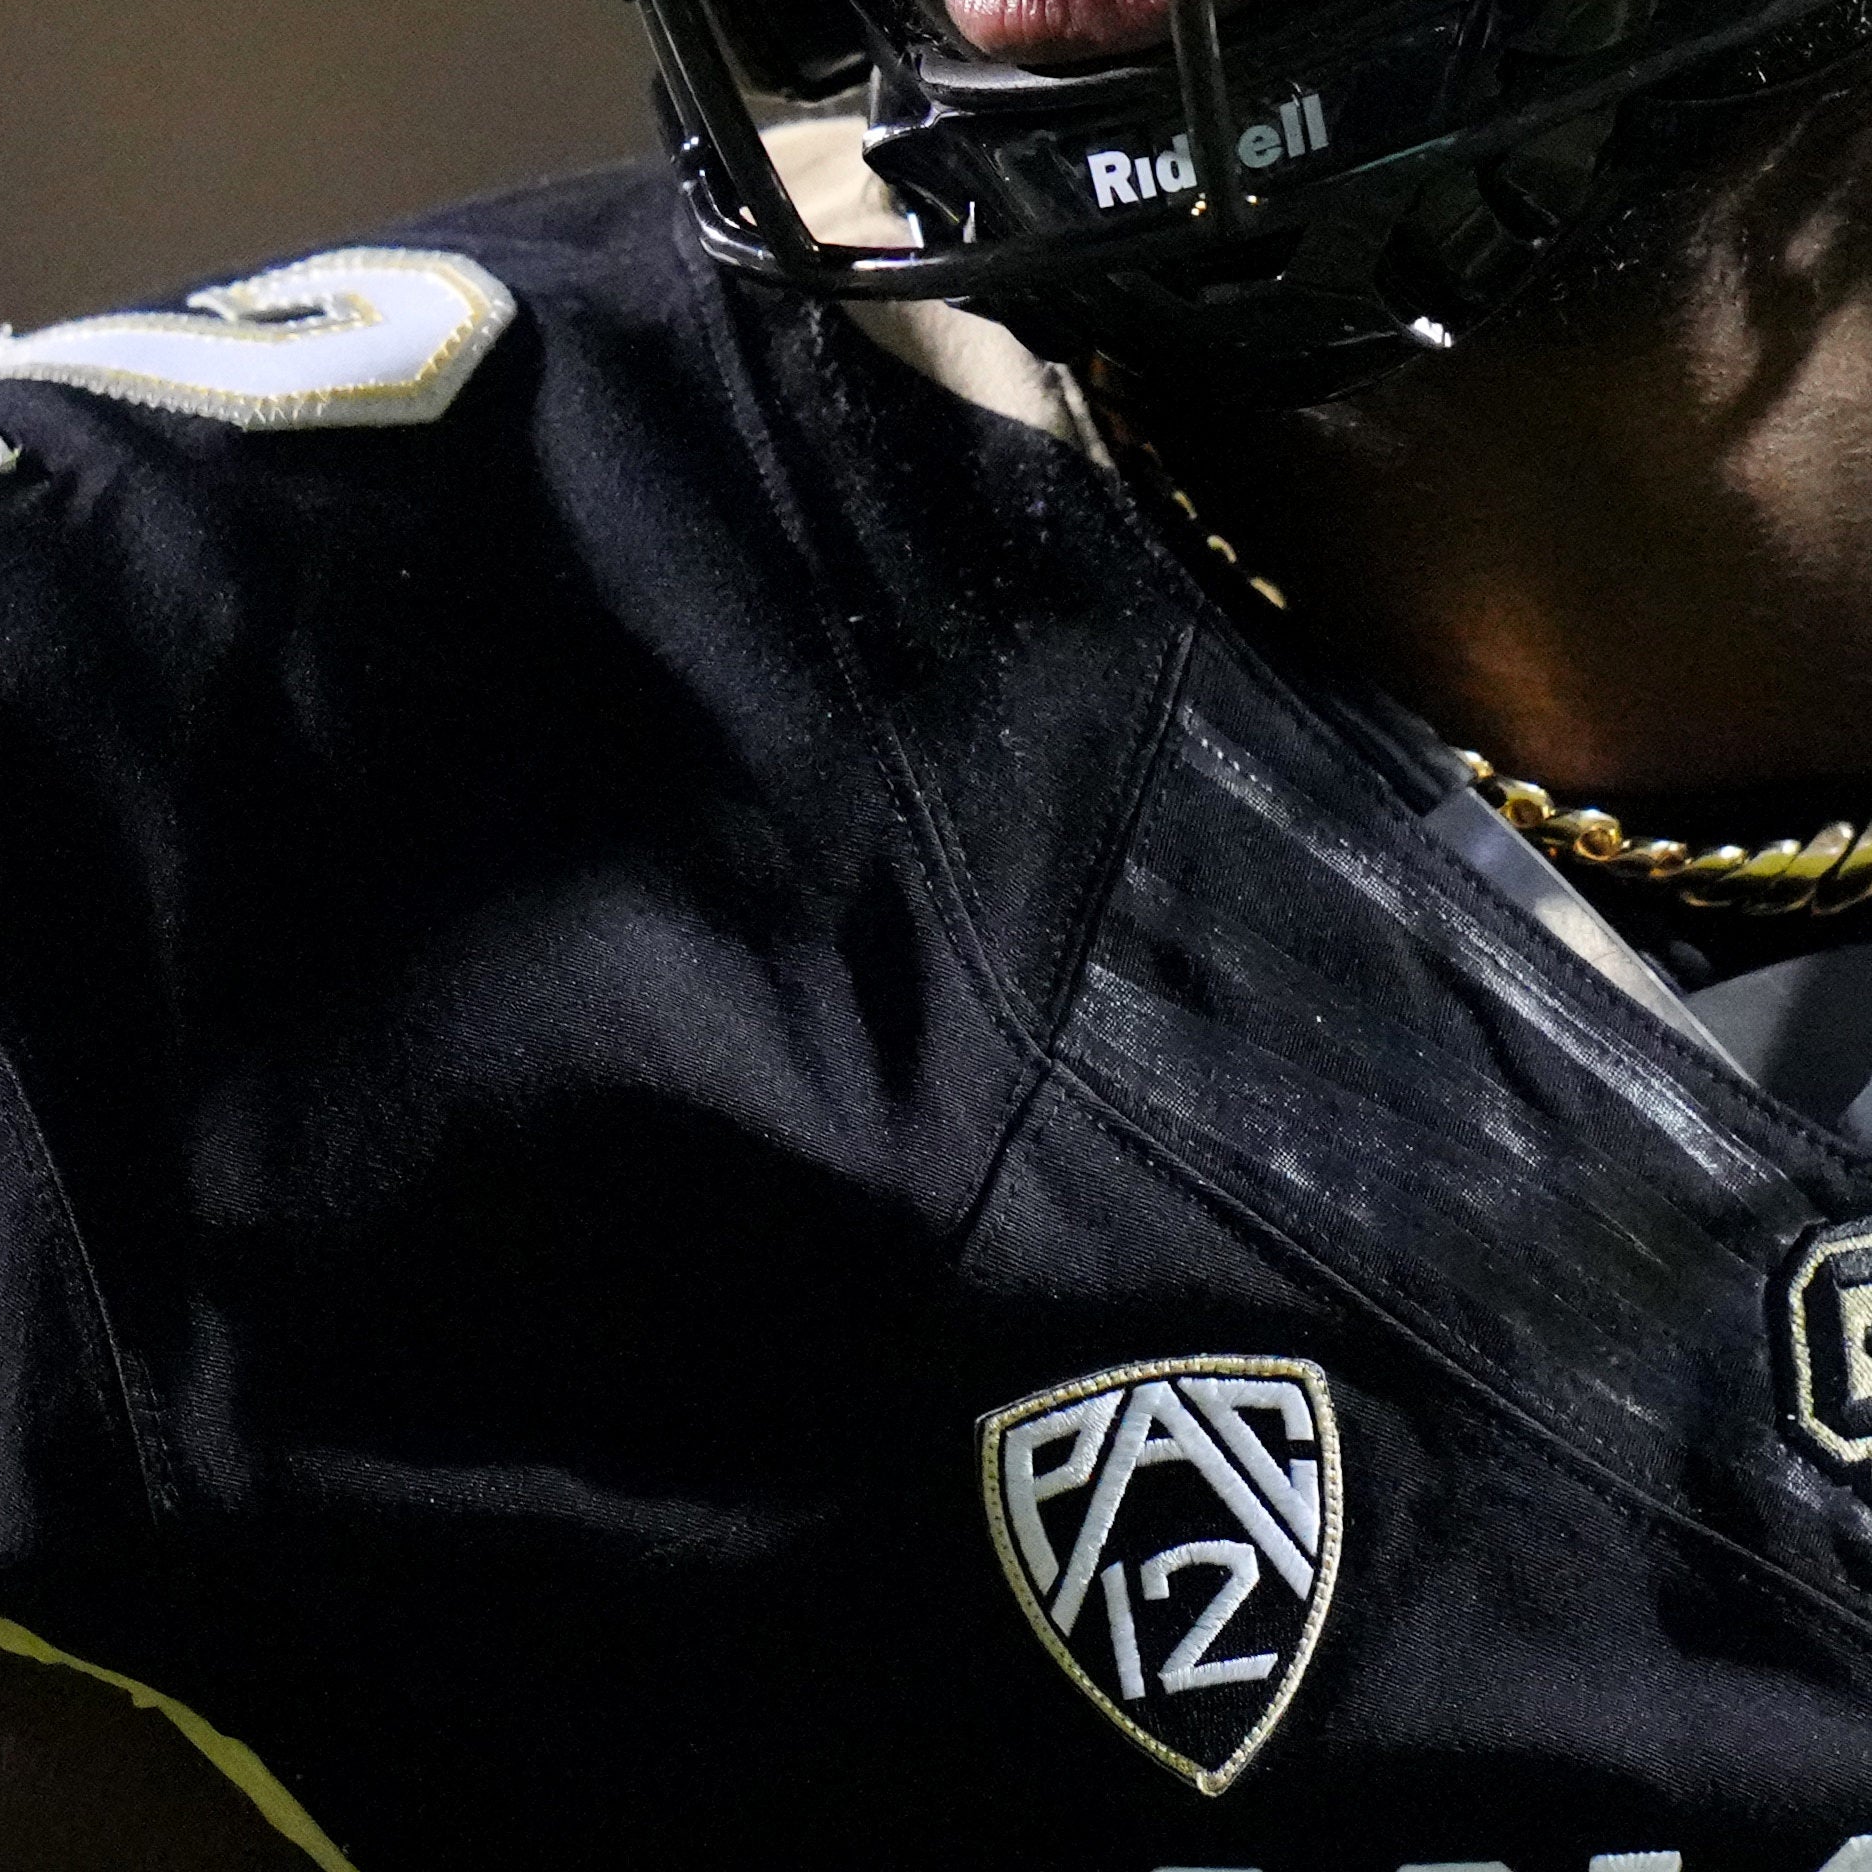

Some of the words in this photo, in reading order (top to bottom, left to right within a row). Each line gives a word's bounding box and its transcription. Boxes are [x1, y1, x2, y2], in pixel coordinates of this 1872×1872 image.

[1086, 93, 1330, 209] Ridell
[1004, 1375, 1321, 1639] PAC
[1100, 1538, 1279, 1701] 12
